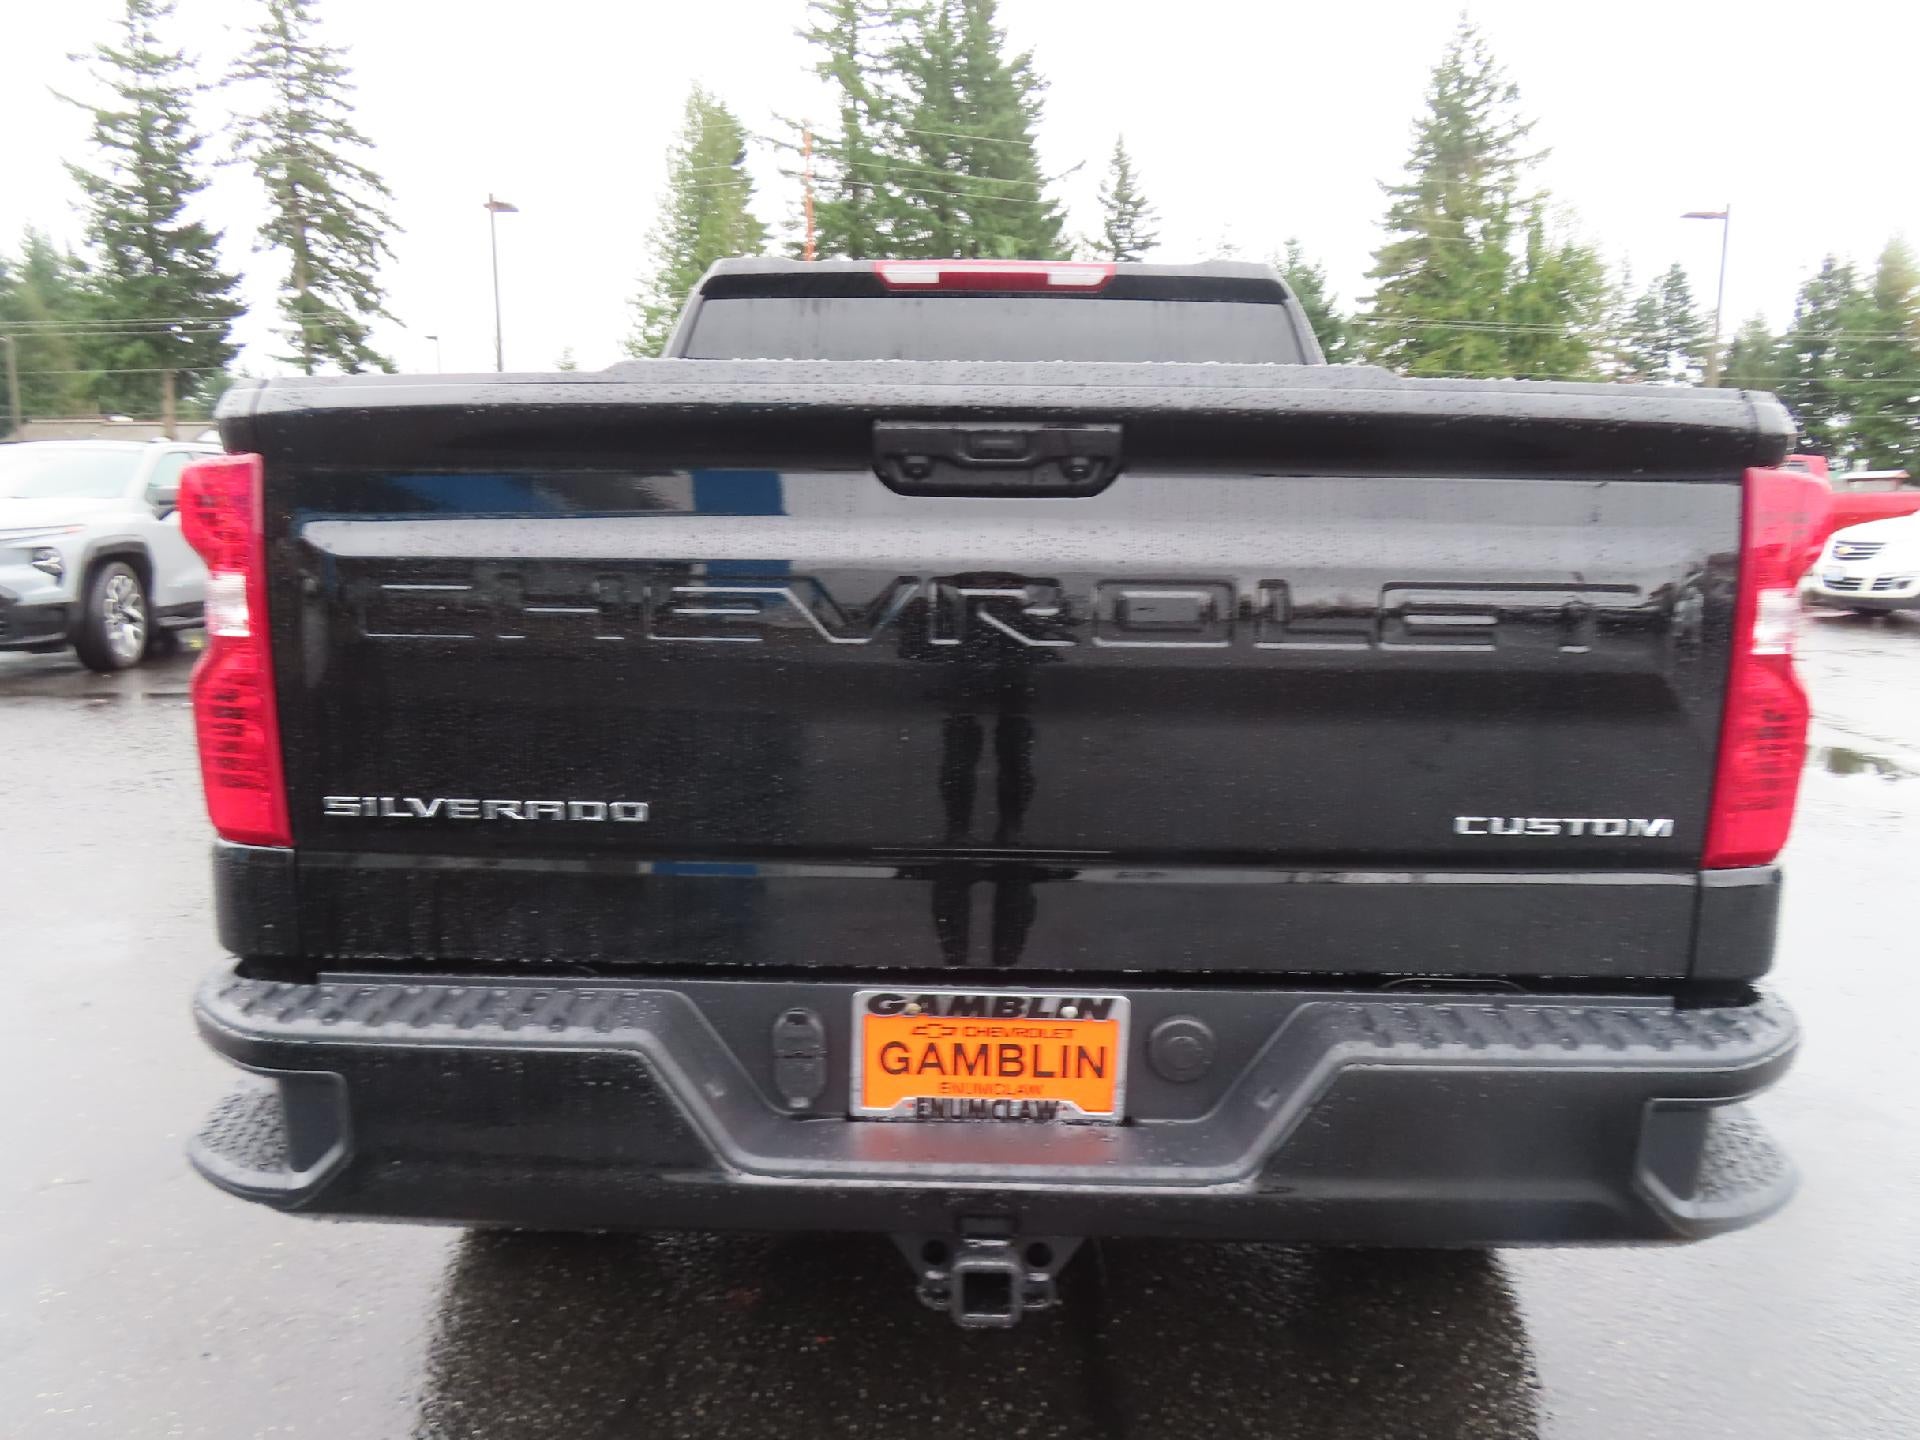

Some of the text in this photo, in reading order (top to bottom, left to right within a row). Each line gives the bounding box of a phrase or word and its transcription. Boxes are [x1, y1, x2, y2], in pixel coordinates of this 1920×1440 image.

[359, 573, 1642, 652] CHEVROLET
[323, 796, 650, 821] SILVERADO
[1453, 817, 1674, 837] CUSTOM
[867, 993, 1113, 1018] GAMBLIN
[962, 1026, 1077, 1038] CHEVROLET
[880, 1041, 1106, 1078] GAMBLIN
